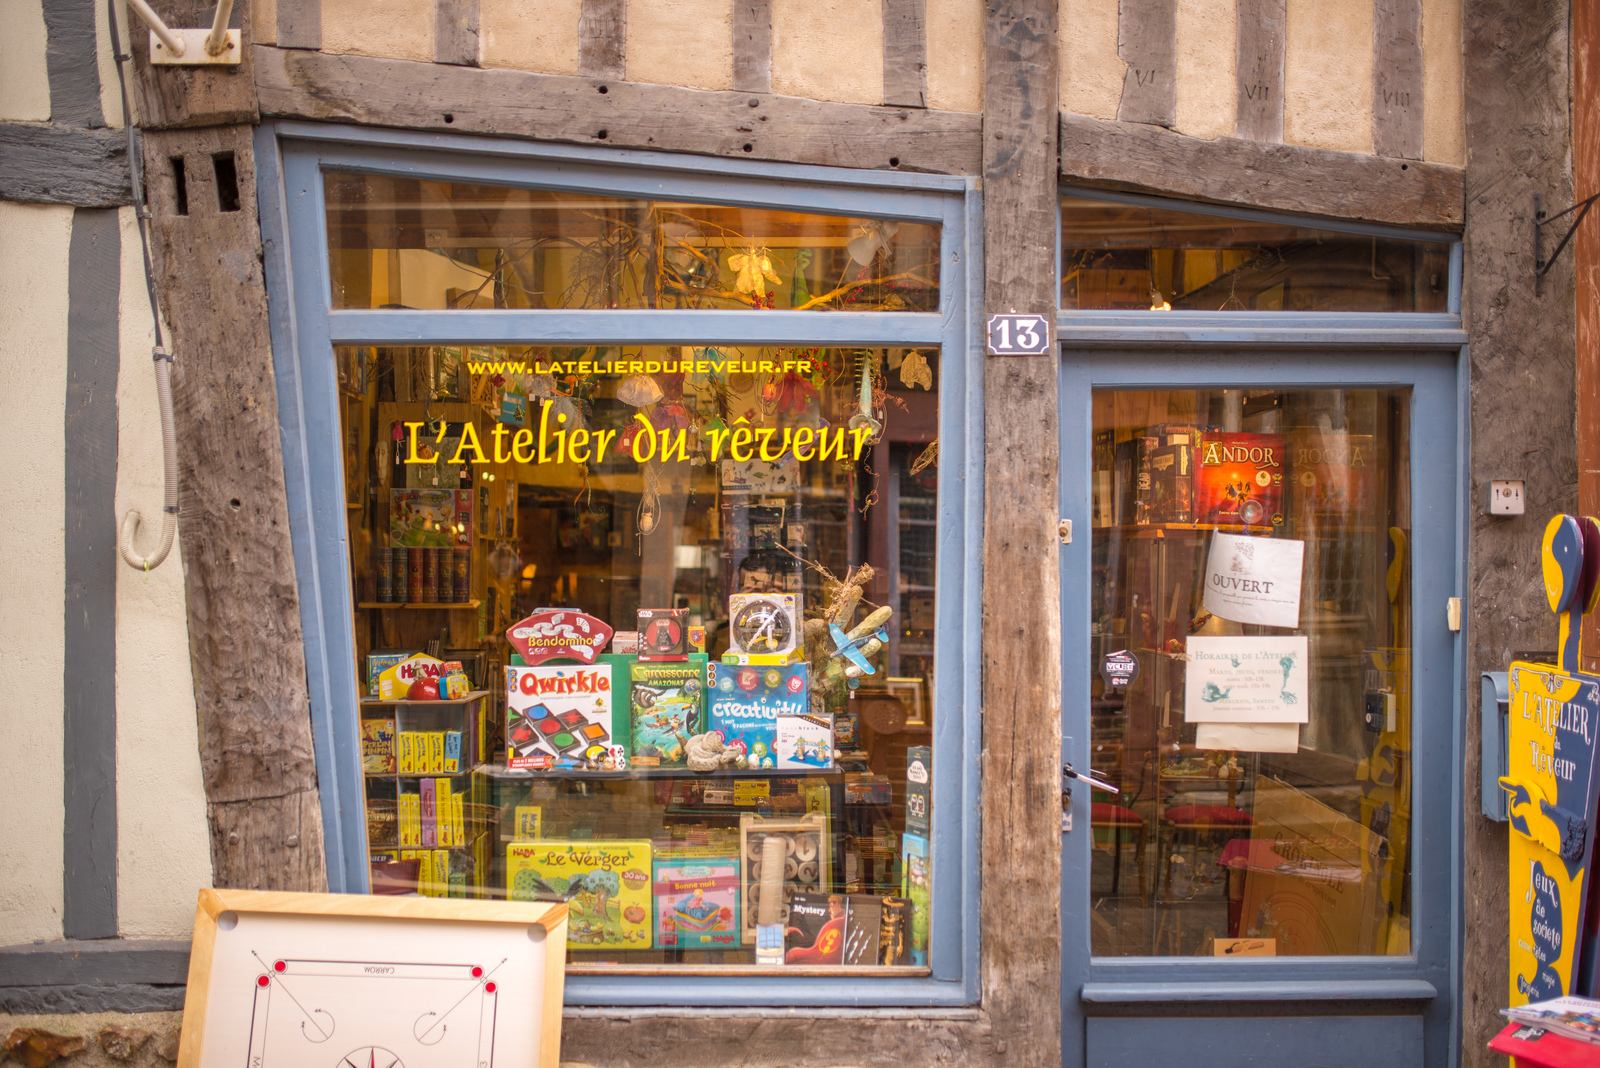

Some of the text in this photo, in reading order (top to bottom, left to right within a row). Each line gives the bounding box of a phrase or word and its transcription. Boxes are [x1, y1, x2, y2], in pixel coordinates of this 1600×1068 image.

[996, 319, 1041, 351] 13
[467, 360, 812, 375] WWW.LATELIERDUREVEUR.FR
[403, 400, 873, 466] L'Atelier du rêveur
[1202, 441, 1280, 470] ANDOR
[1212, 573, 1274, 594] OUVERT
[528, 635, 593, 647] Bendomino
[519, 670, 611, 697] Qwirkle
[648, 679, 685, 687] AMAZONAS
[1523, 692, 1591, 746] L'ATELIER
[546, 851, 566, 866] Le
[1526, 860, 1559, 908] Jeux
[793, 903, 826, 917] Mystery
